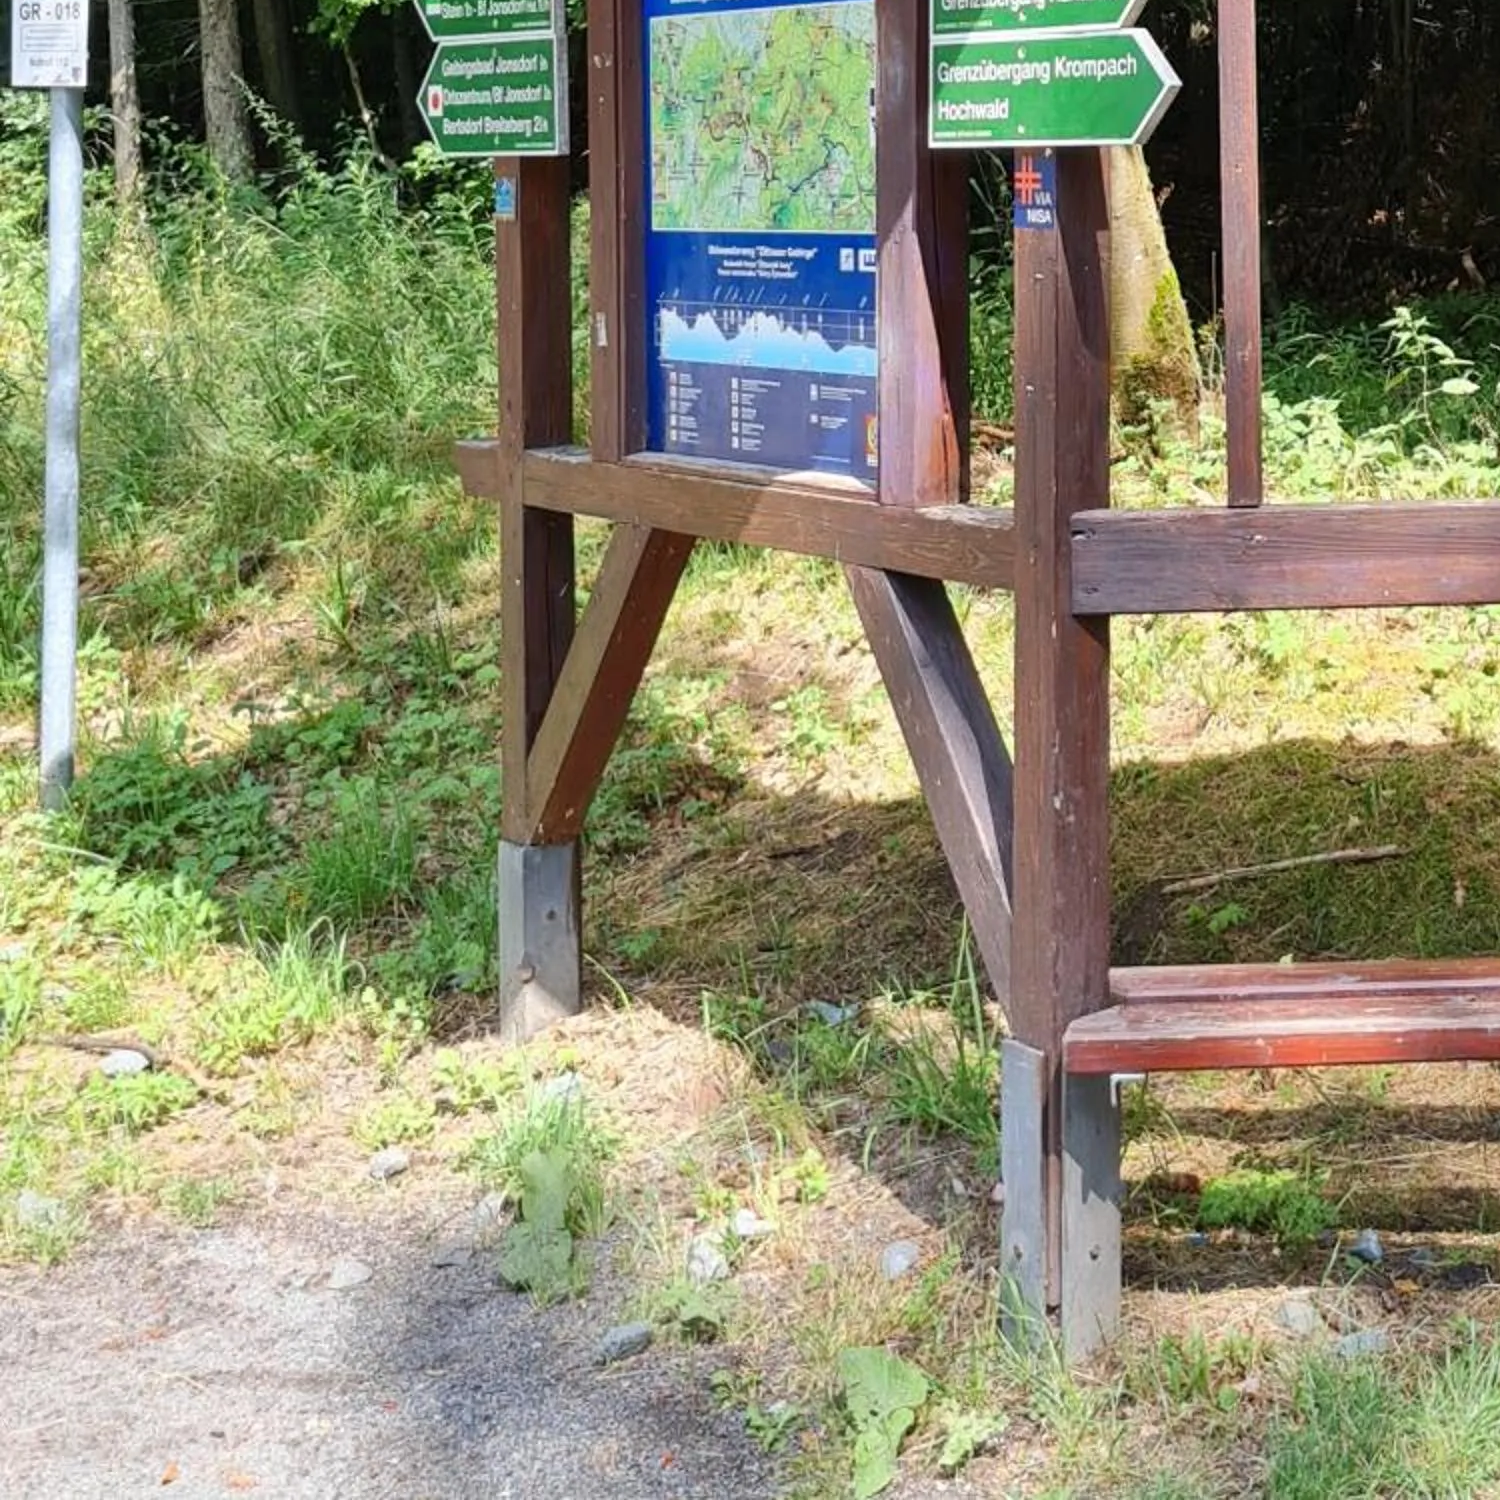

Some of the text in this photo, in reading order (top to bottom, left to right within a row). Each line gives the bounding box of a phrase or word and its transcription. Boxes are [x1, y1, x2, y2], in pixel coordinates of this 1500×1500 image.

[19, 2, 41, 21] GR
[938, 52, 1137, 86] Grenzübergang Krompach
[938, 97, 1009, 121] Hochwald
[1034, 190, 1053, 205] VIA
[1027, 208, 1052, 224] NISA
